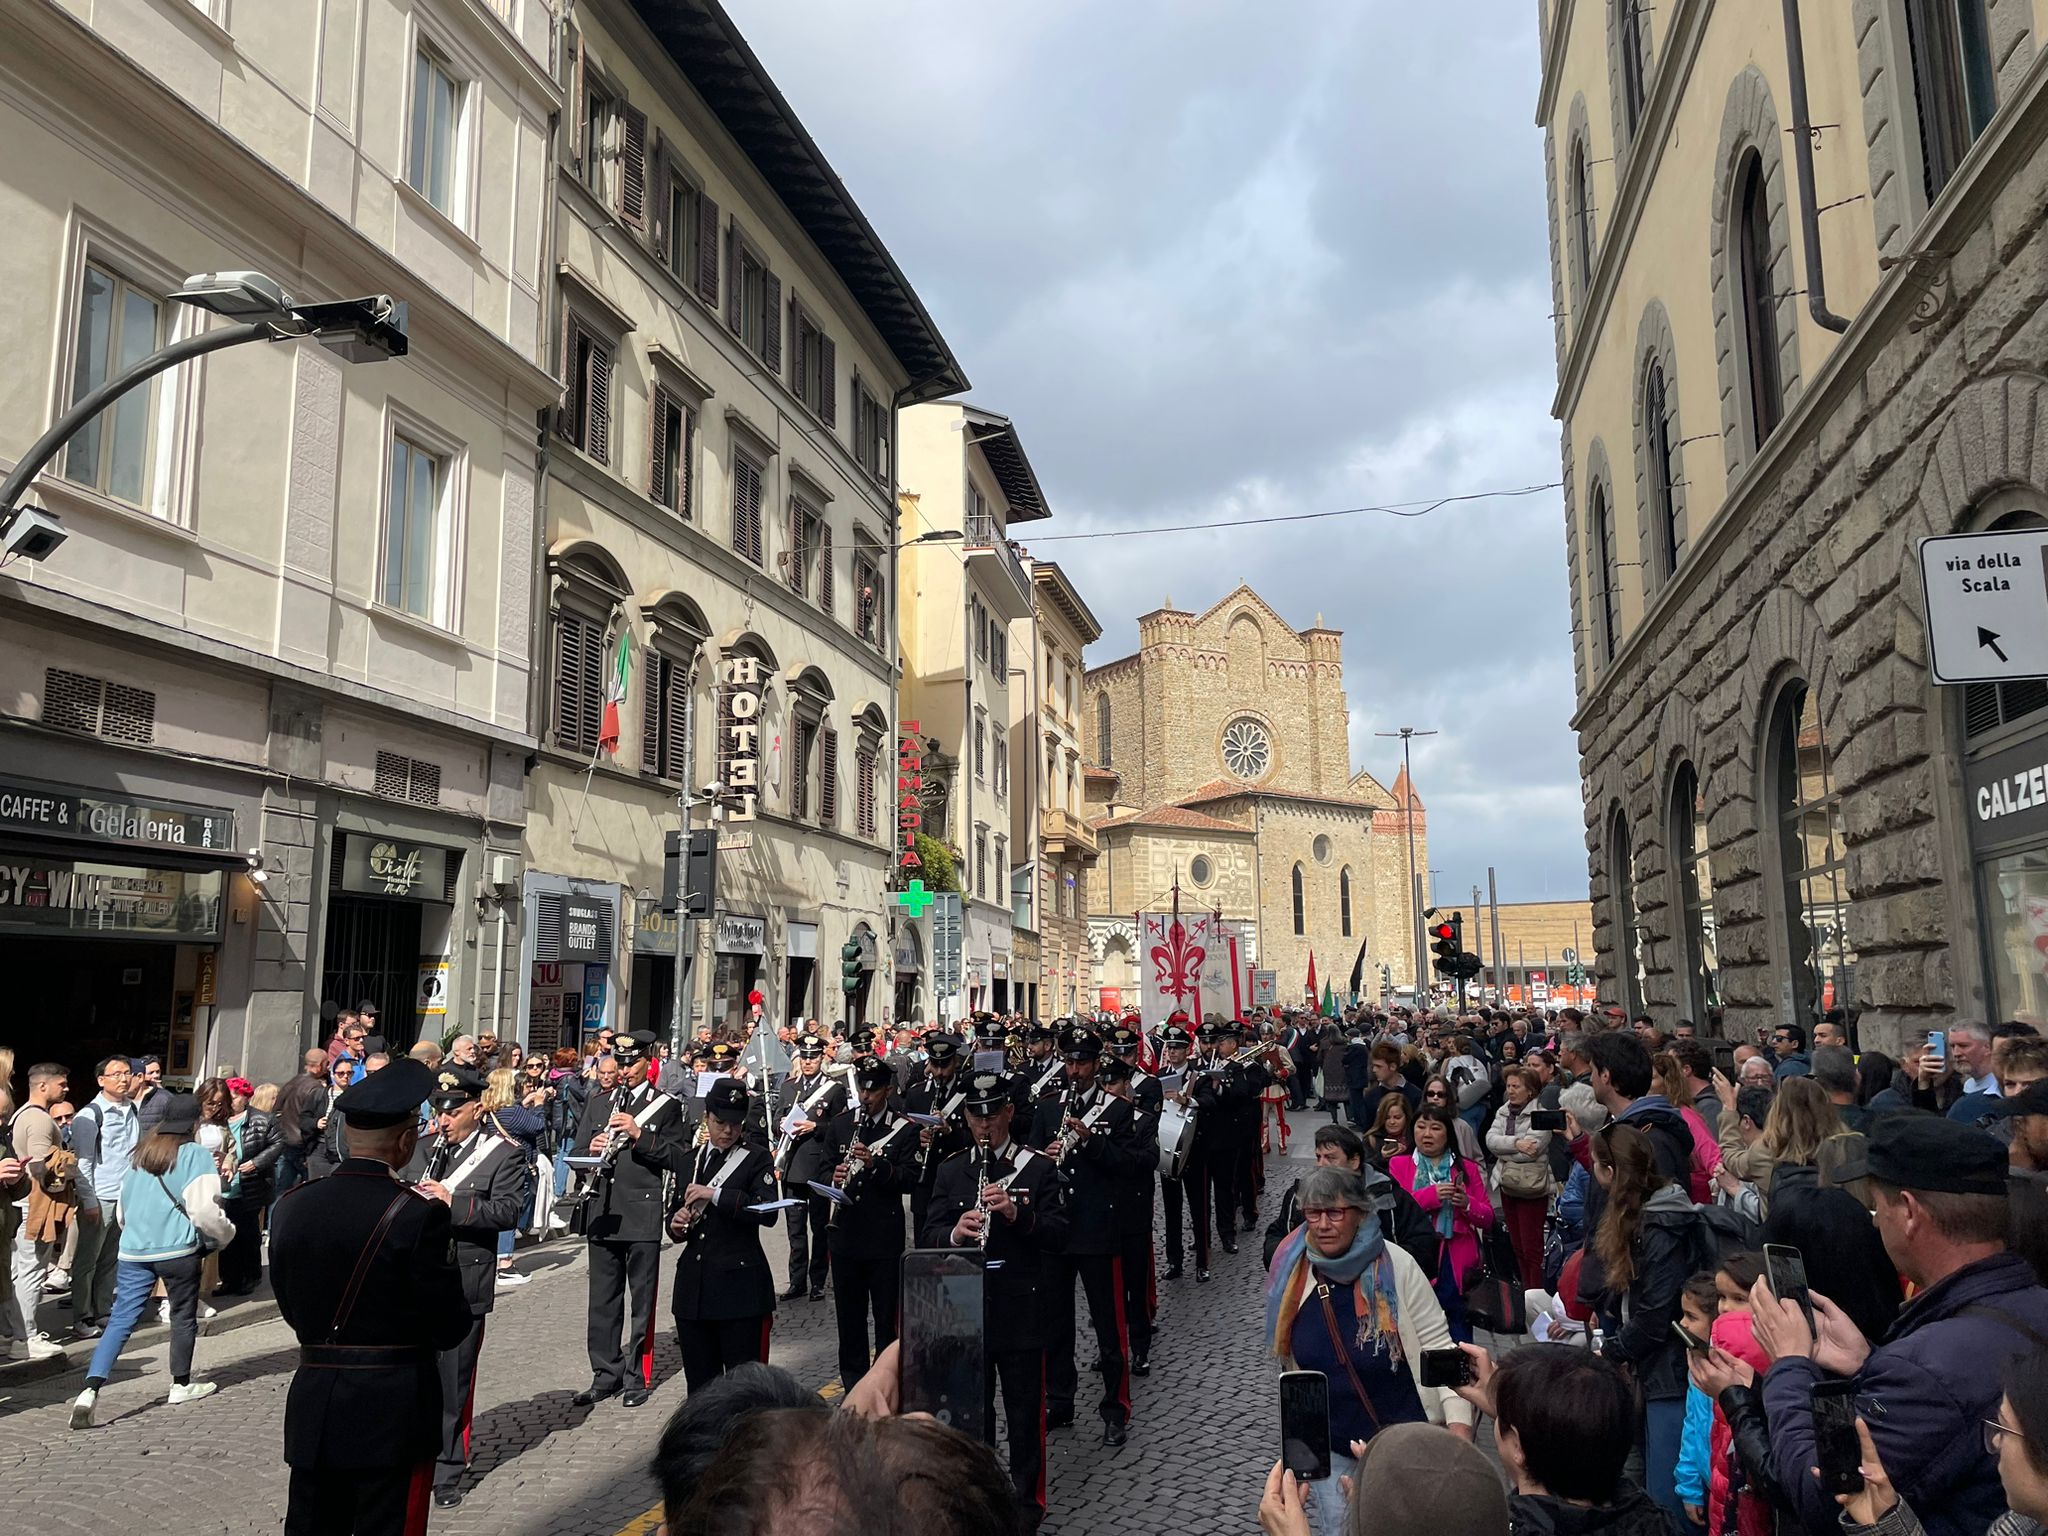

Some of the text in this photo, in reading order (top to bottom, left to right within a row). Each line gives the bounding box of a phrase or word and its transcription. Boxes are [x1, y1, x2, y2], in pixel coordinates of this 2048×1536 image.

[1945, 552, 2022, 571] via della
[1962, 575, 2011, 593] Scala
[1976, 763, 2048, 821] CALZE
[57, 802, 69, 825] &
[89, 804, 186, 844] Gelateria
[202, 817, 213, 848] BAR
[47, 870, 110, 911] WINE
[568, 921, 597, 936] BRANDS
[568, 936, 596, 950] OUTLET
